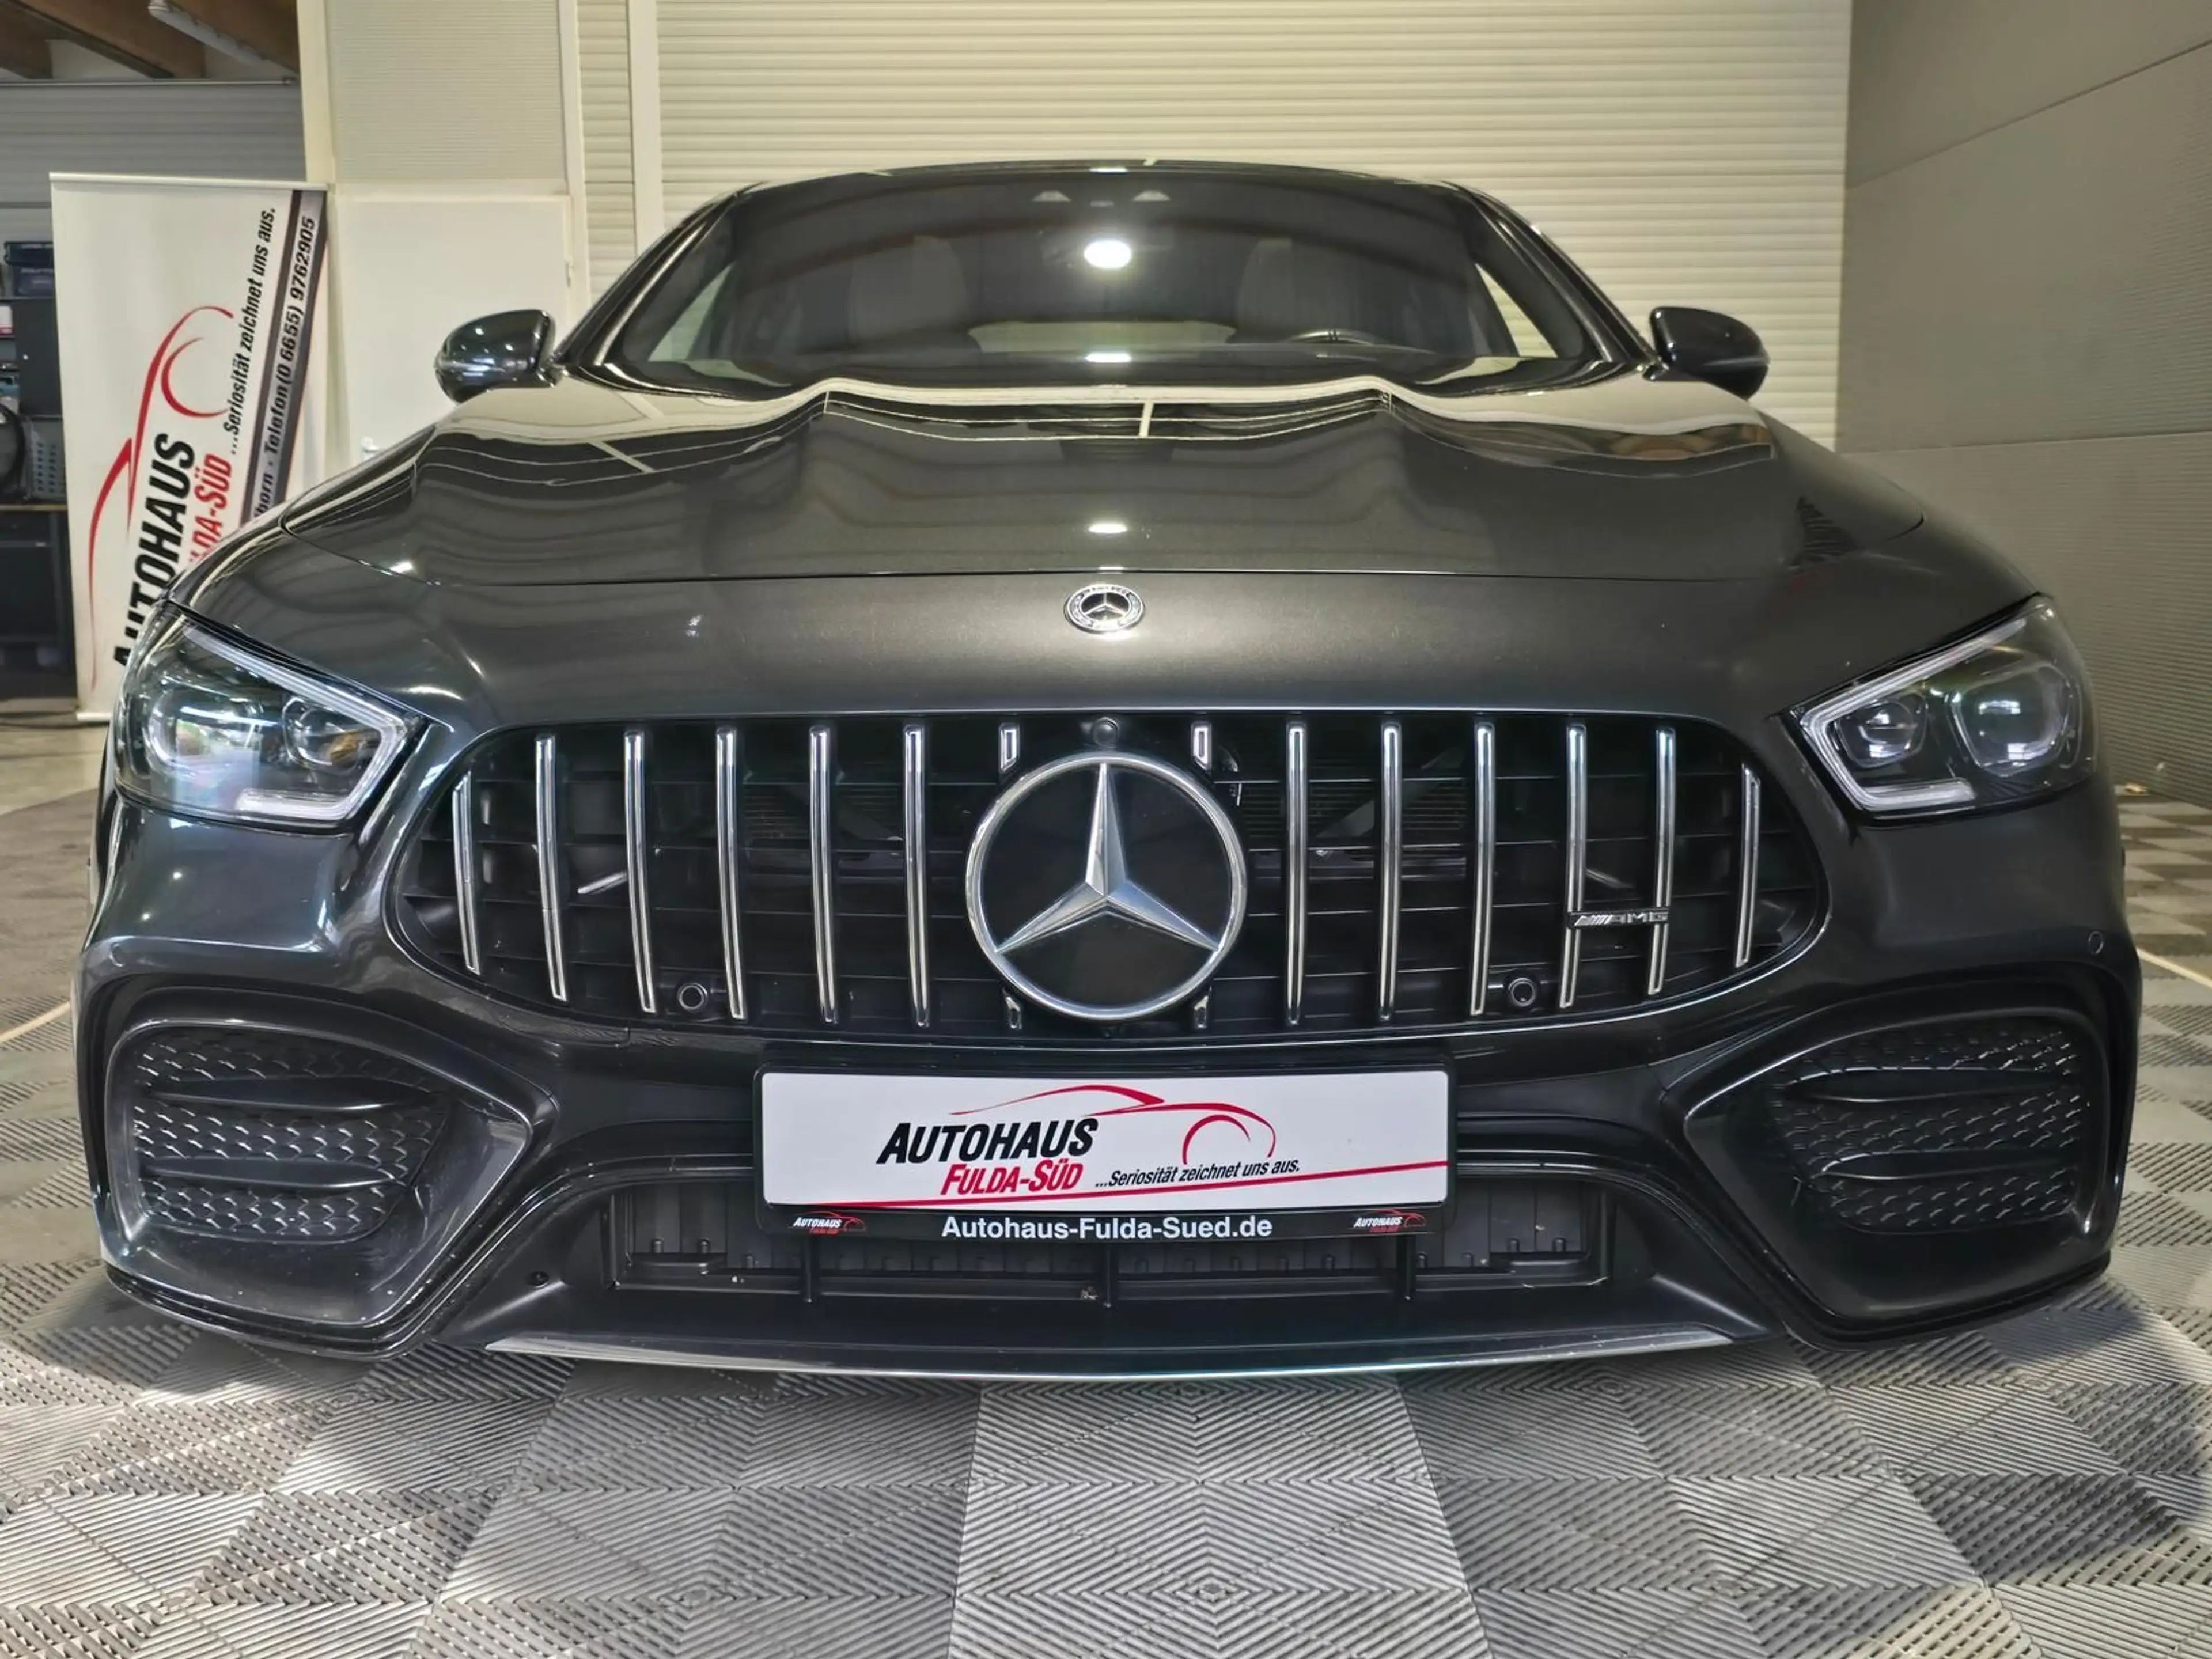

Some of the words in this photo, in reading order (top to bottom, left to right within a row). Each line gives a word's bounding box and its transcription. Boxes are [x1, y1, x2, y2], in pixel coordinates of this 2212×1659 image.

[257, 207, 276, 243] aus.
[252, 244, 269, 276] uns
[238, 278, 263, 353] zeichnet
[264, 384, 288, 454] Telefon
[290, 217, 315, 301] 9762905
[223, 353, 251, 455] ...Seriosität
[876, 1118, 1099, 1165] AUTOHAUS
[940, 1158, 1084, 1195] FULDA-SÜD
[1095, 1164, 1179, 1187] ...Seriosität
[1179, 1161, 1242, 1182] zeichnet
[1242, 1162, 1269, 1177] uns
[1271, 1159, 1300, 1174] aus.
[941, 1215, 1273, 1240] Autohaus-Fulda-Sued.de
